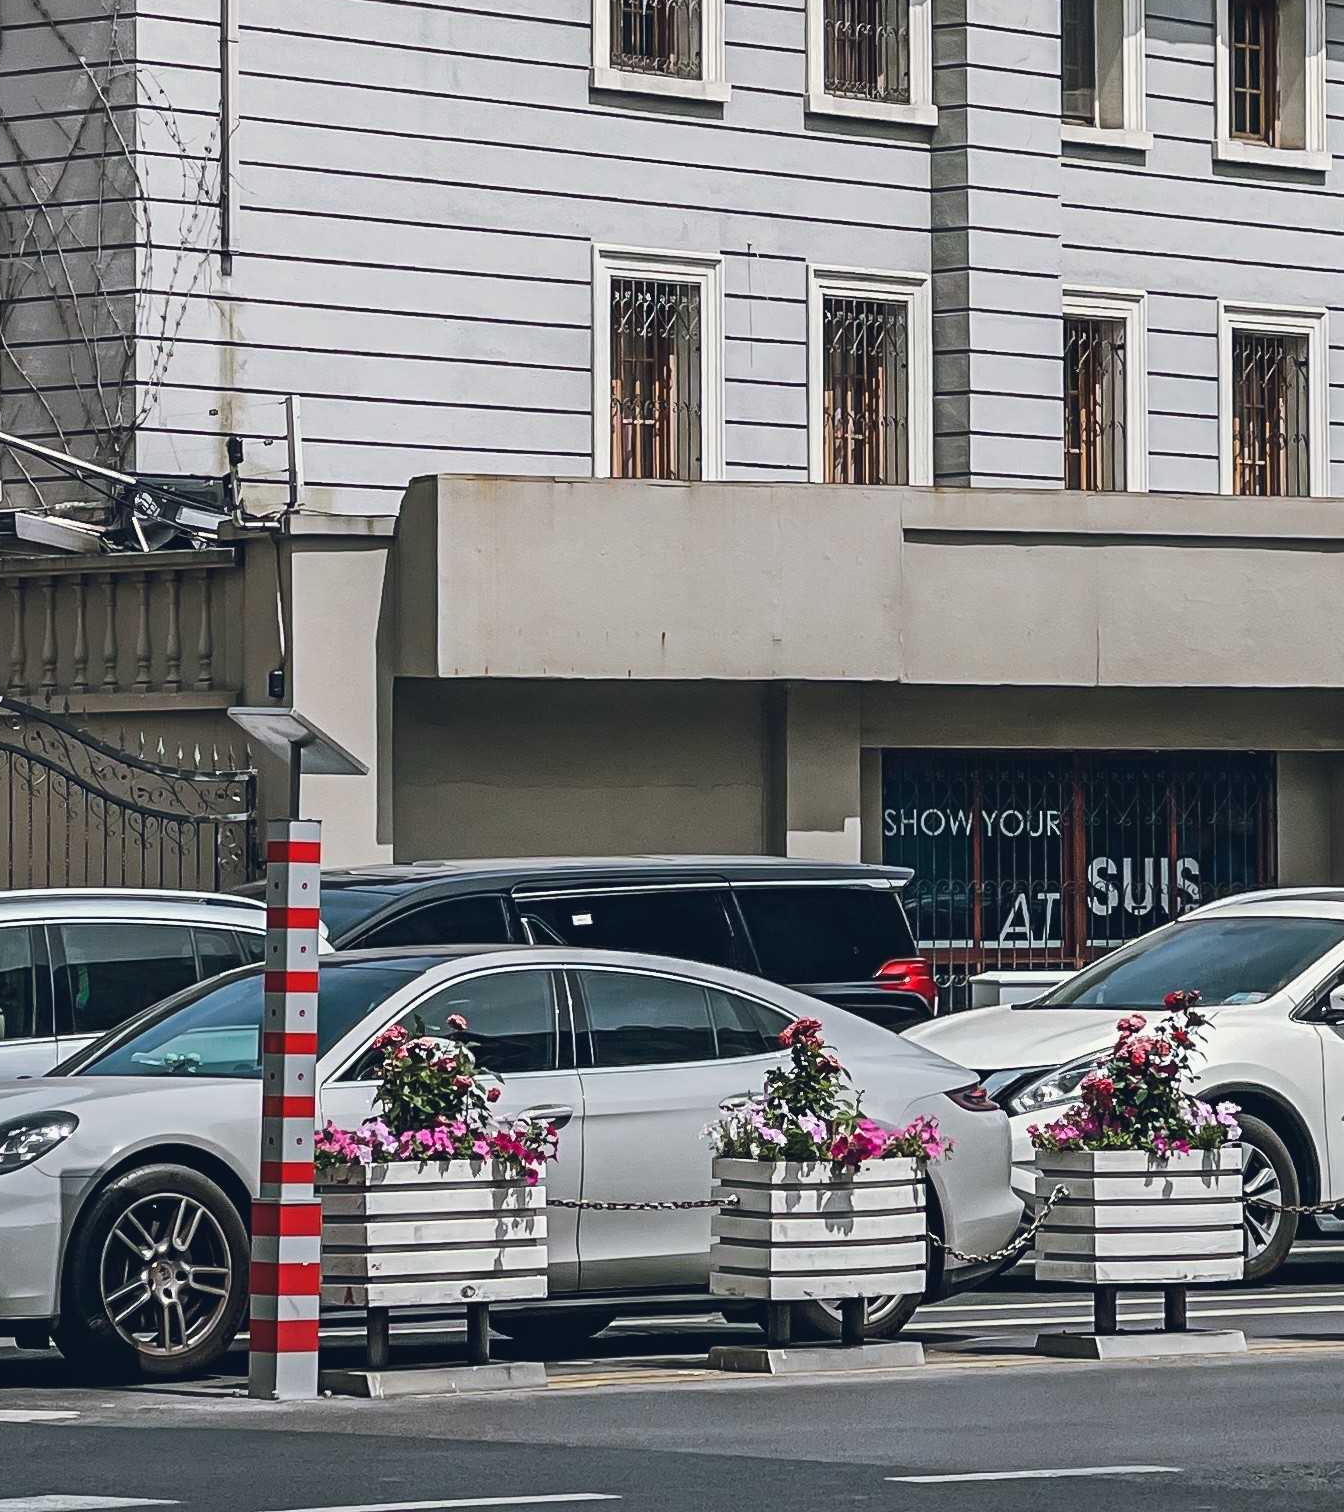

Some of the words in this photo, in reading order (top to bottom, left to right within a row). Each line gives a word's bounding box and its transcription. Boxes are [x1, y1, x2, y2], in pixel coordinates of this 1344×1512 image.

[884, 808, 973, 837] SHOW
[982, 809, 1062, 837] YOUR
[999, 892, 1061, 945] AT
